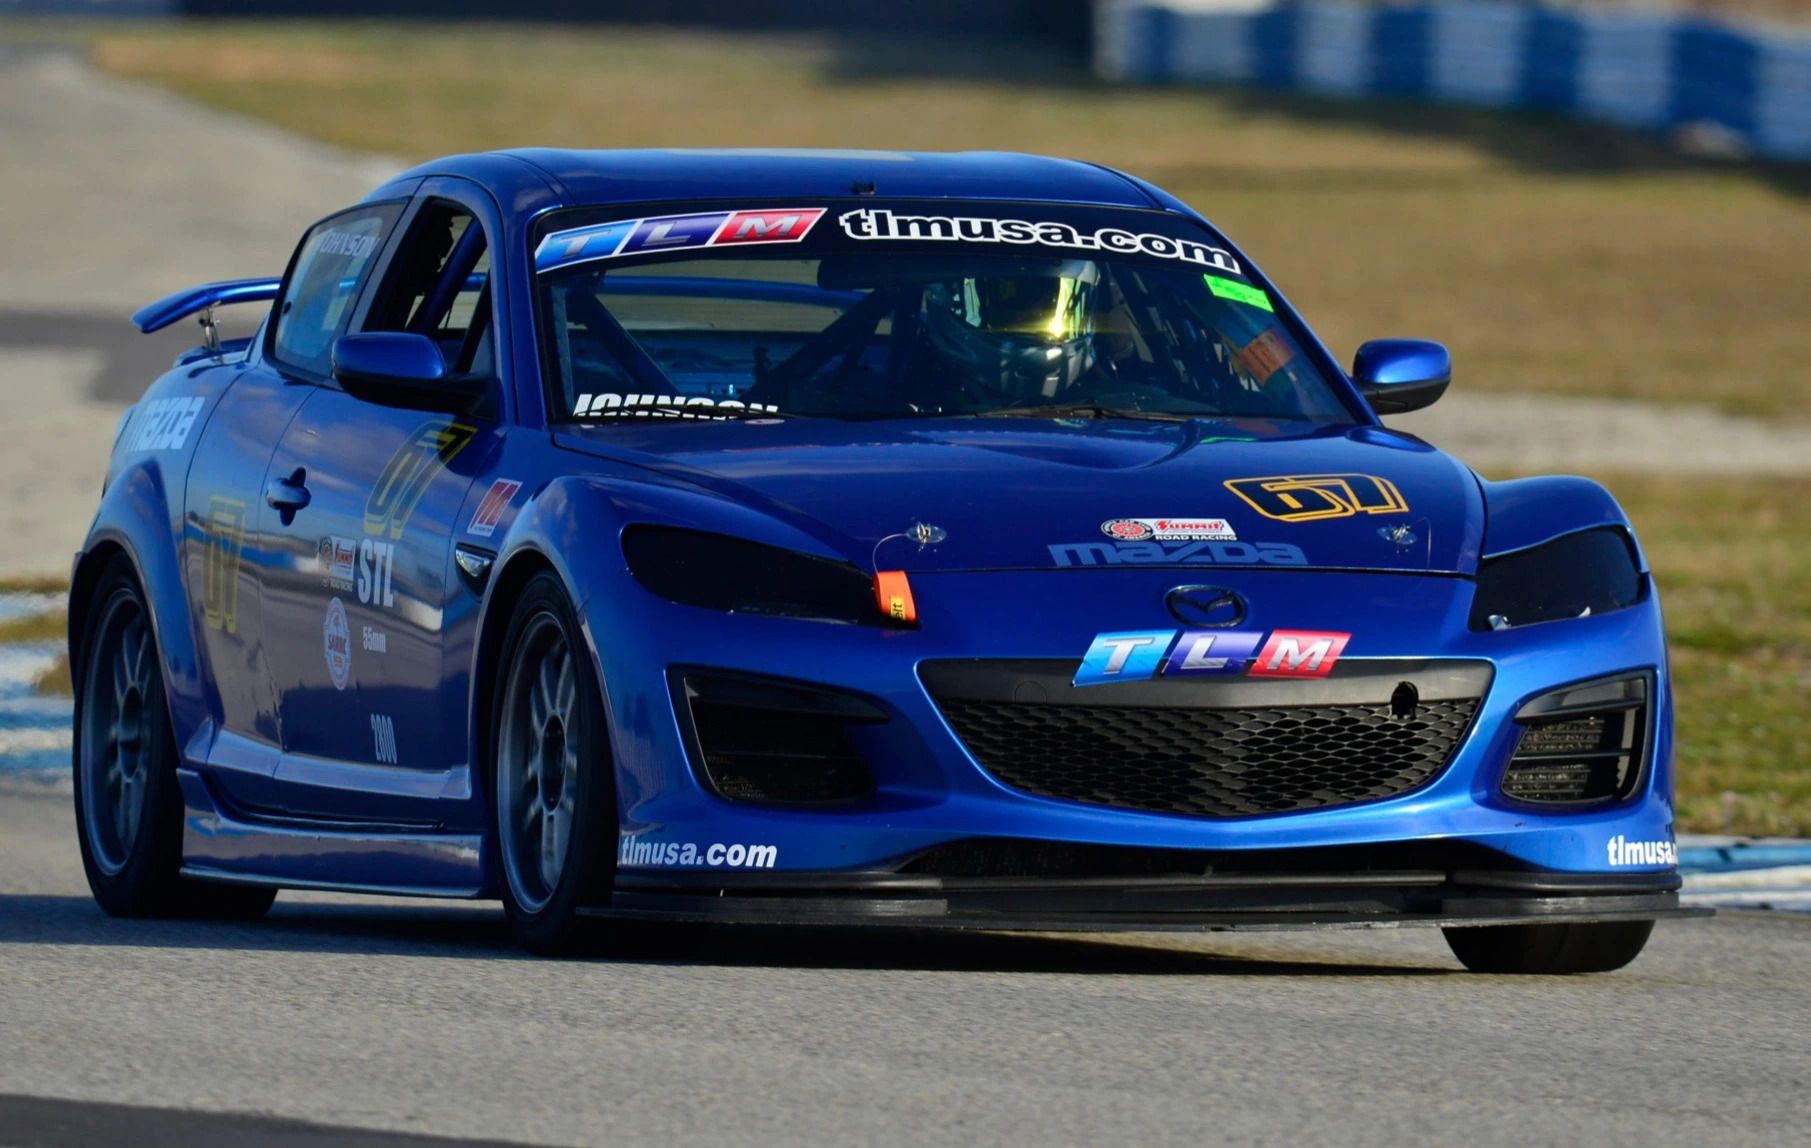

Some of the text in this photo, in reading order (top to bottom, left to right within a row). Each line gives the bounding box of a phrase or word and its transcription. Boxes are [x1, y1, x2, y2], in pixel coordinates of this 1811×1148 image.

[558, 214, 802, 259] TLM
[839, 208, 1241, 274] tlmusa.com
[358, 538, 394, 607] STL
[1102, 635, 1334, 676] TLM
[370, 713, 398, 764] 2800
[621, 835, 777, 868] tlmusa.com
